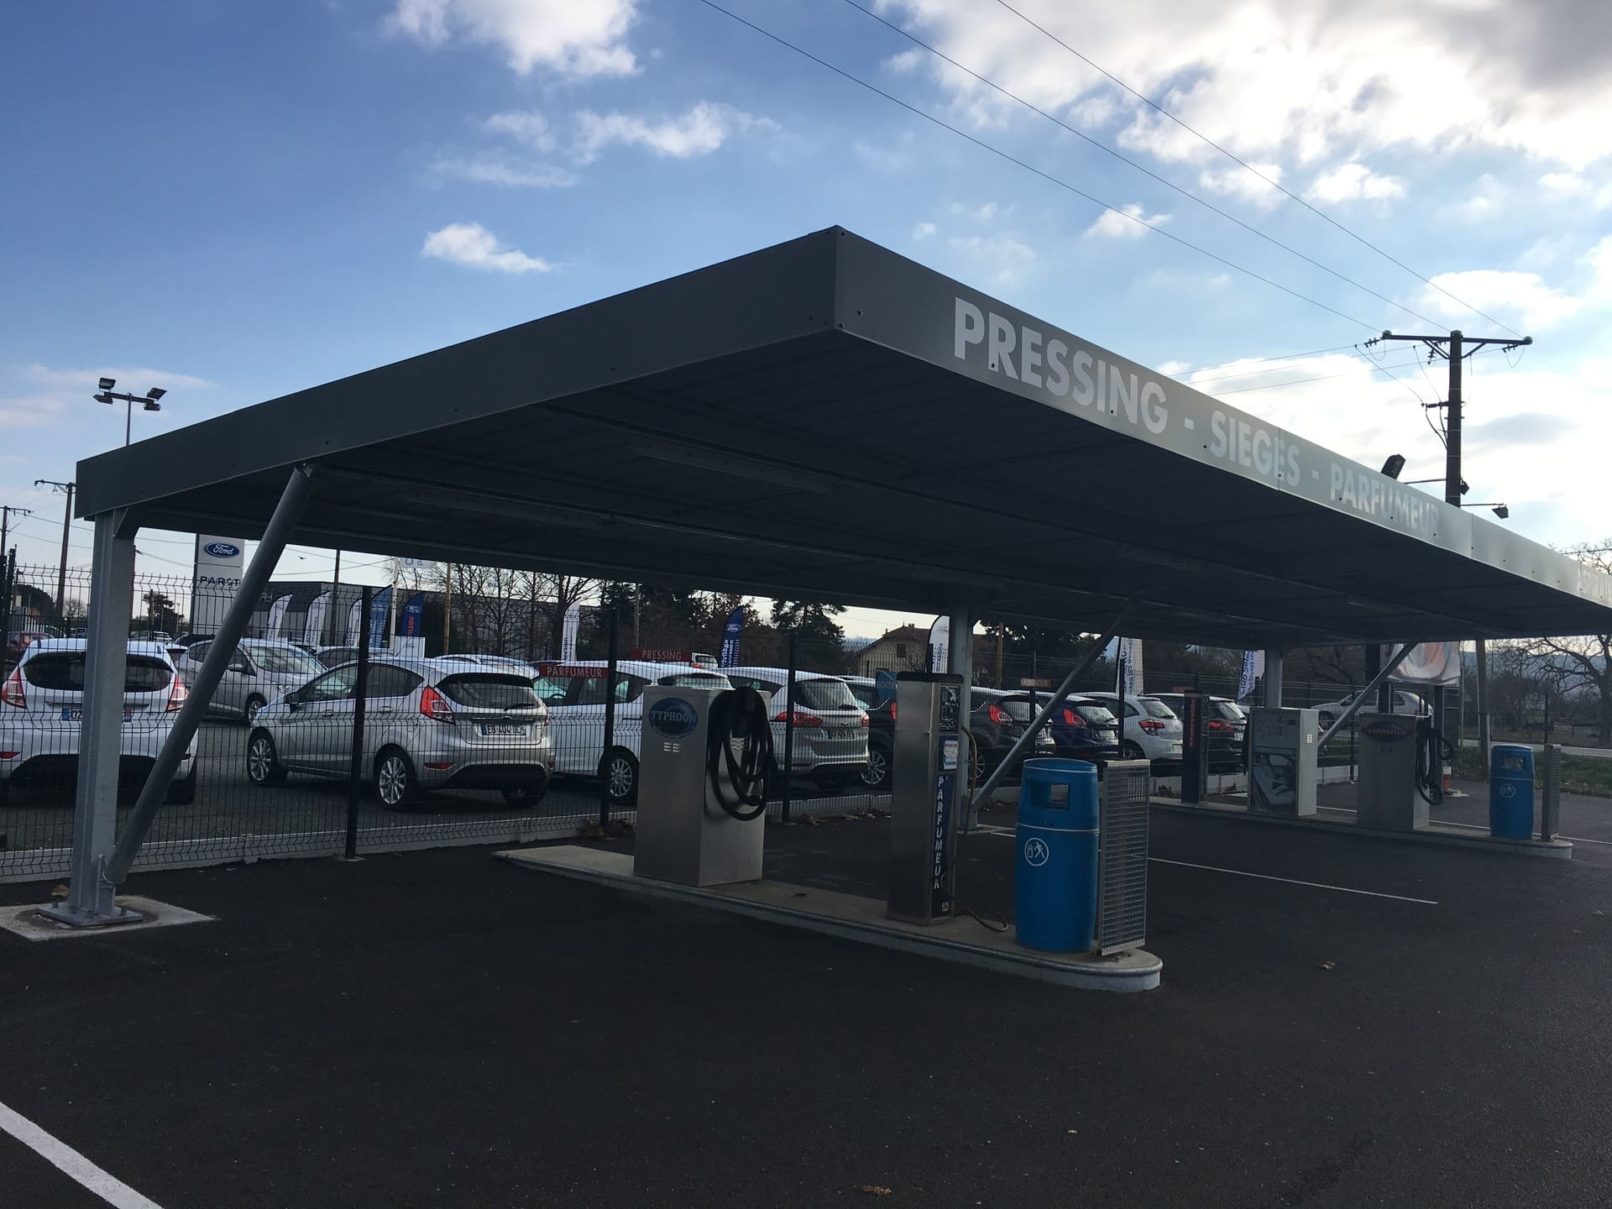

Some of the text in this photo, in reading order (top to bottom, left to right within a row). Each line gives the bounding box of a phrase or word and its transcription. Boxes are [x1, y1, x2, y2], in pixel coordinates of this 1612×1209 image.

[954, 297, 1168, 434] PRESSING
[1210, 410, 1300, 487] SIEGES
[1330, 462, 1440, 533] PARFUMEUR
[212, 543, 234, 555] Ford
[641, 650, 682, 661] PRESSING
[546, 666, 603, 678] PARFUMEUR
[651, 710, 697, 724] TYPHOON
